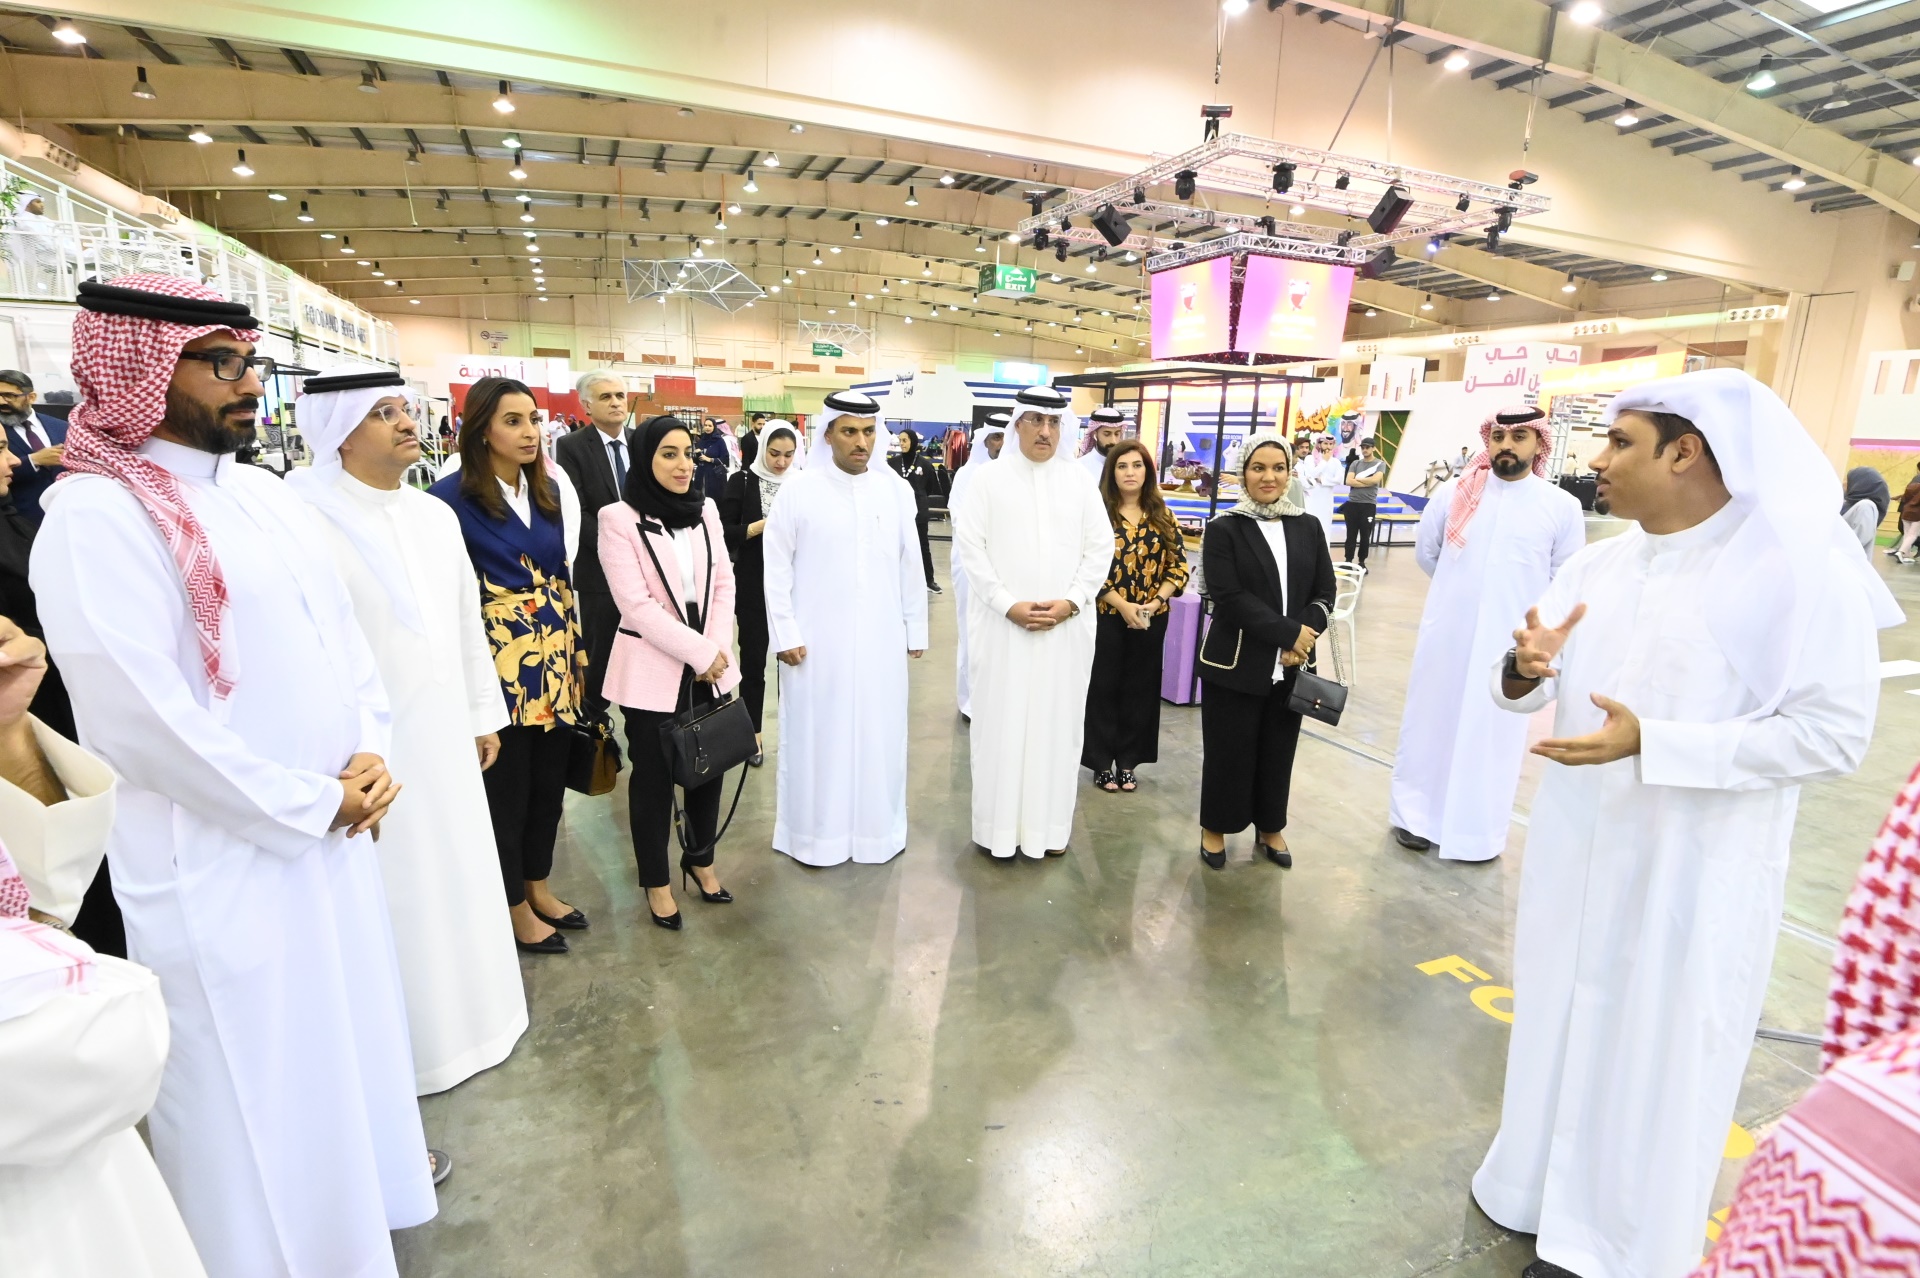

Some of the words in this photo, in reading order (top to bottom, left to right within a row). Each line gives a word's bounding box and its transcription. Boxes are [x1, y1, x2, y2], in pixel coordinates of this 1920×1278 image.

[1004, 282, 1027, 292] EXIT
[1485, 345, 1528, 365] حي
[1546, 347, 1578, 365] حي
[1465, 367, 1526, 393] الفن
[680, 405, 709, 414] WEIGHTS
